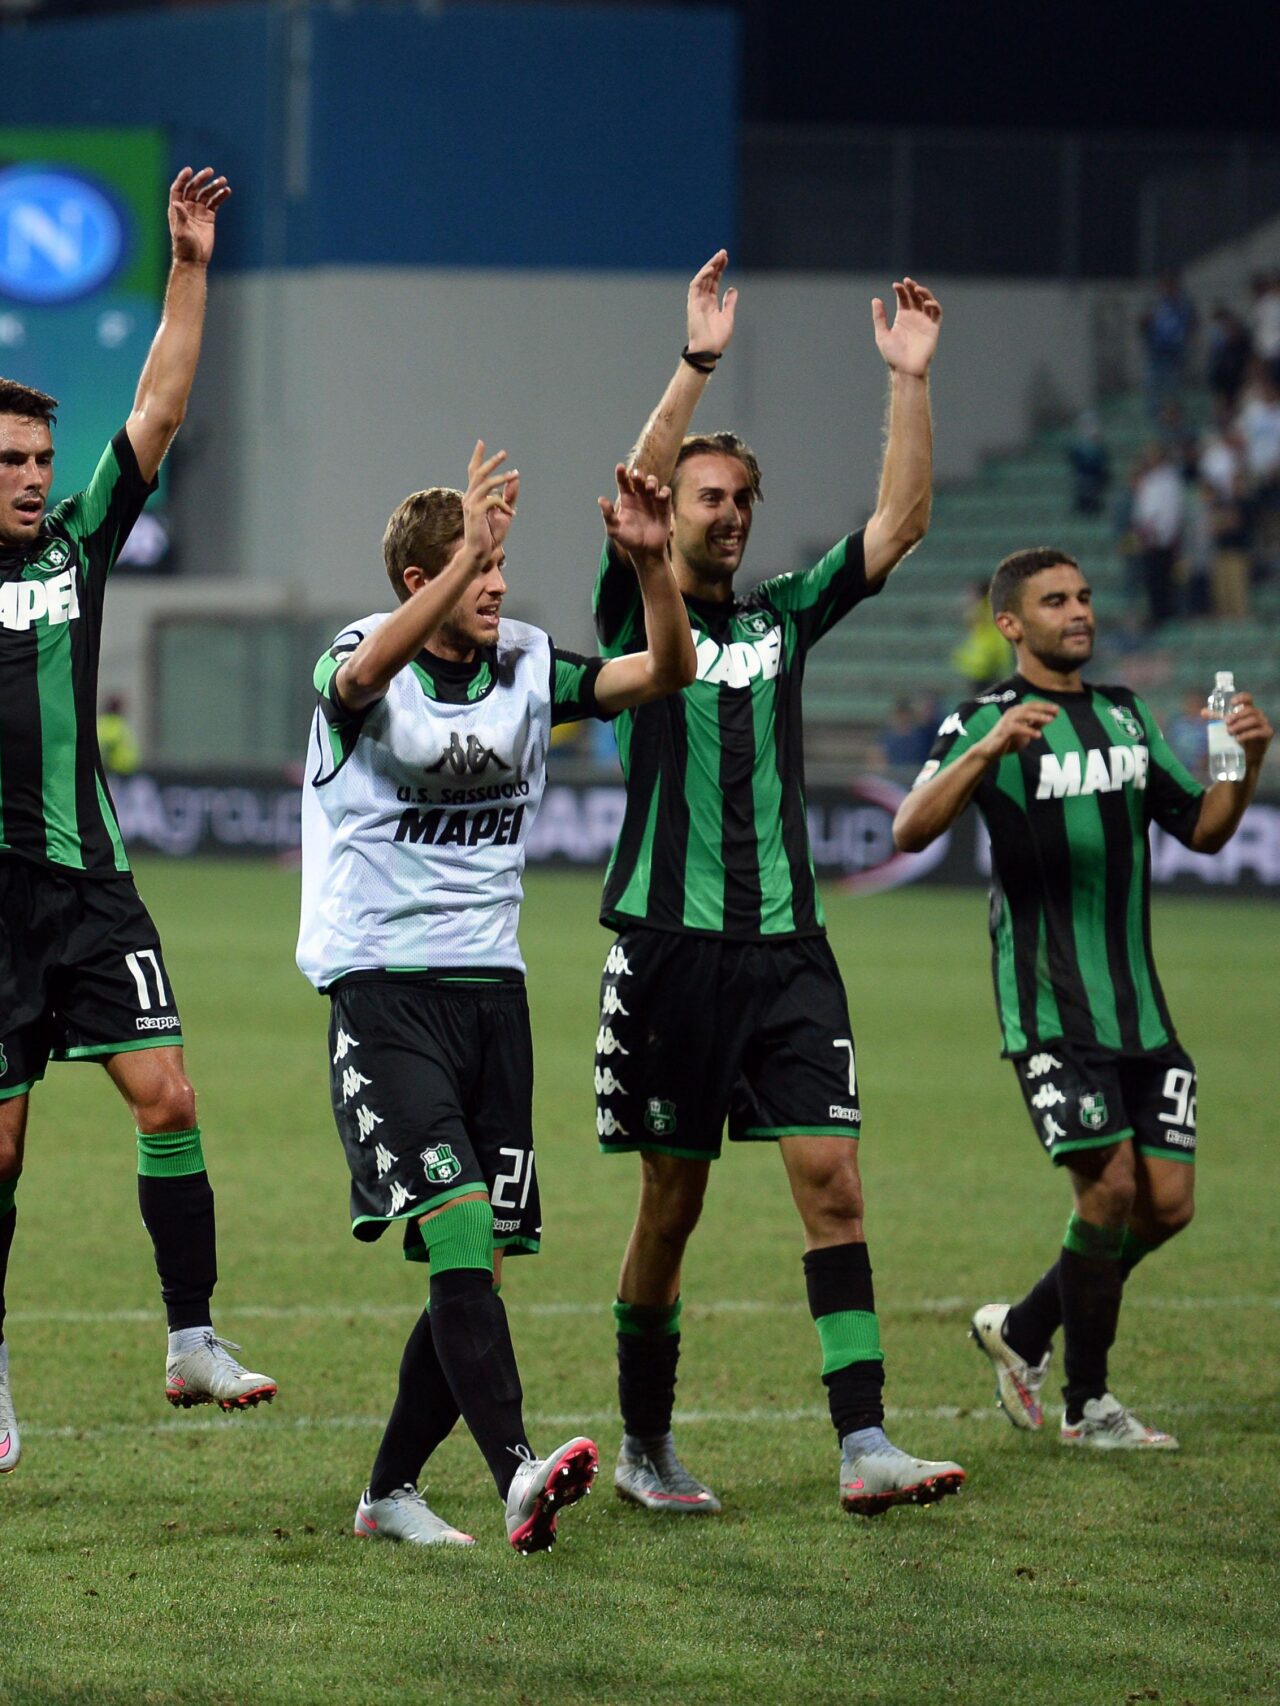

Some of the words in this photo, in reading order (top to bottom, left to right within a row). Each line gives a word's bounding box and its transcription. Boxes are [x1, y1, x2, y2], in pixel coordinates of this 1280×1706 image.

[440, 780, 529, 805] SASSUOLO
[393, 803, 525, 847] MAPEI
[125, 949, 168, 1010] 17
[832, 1038, 856, 1097] 7
[828, 1104, 862, 1122] Kapp
[490, 1147, 535, 1209] 21
